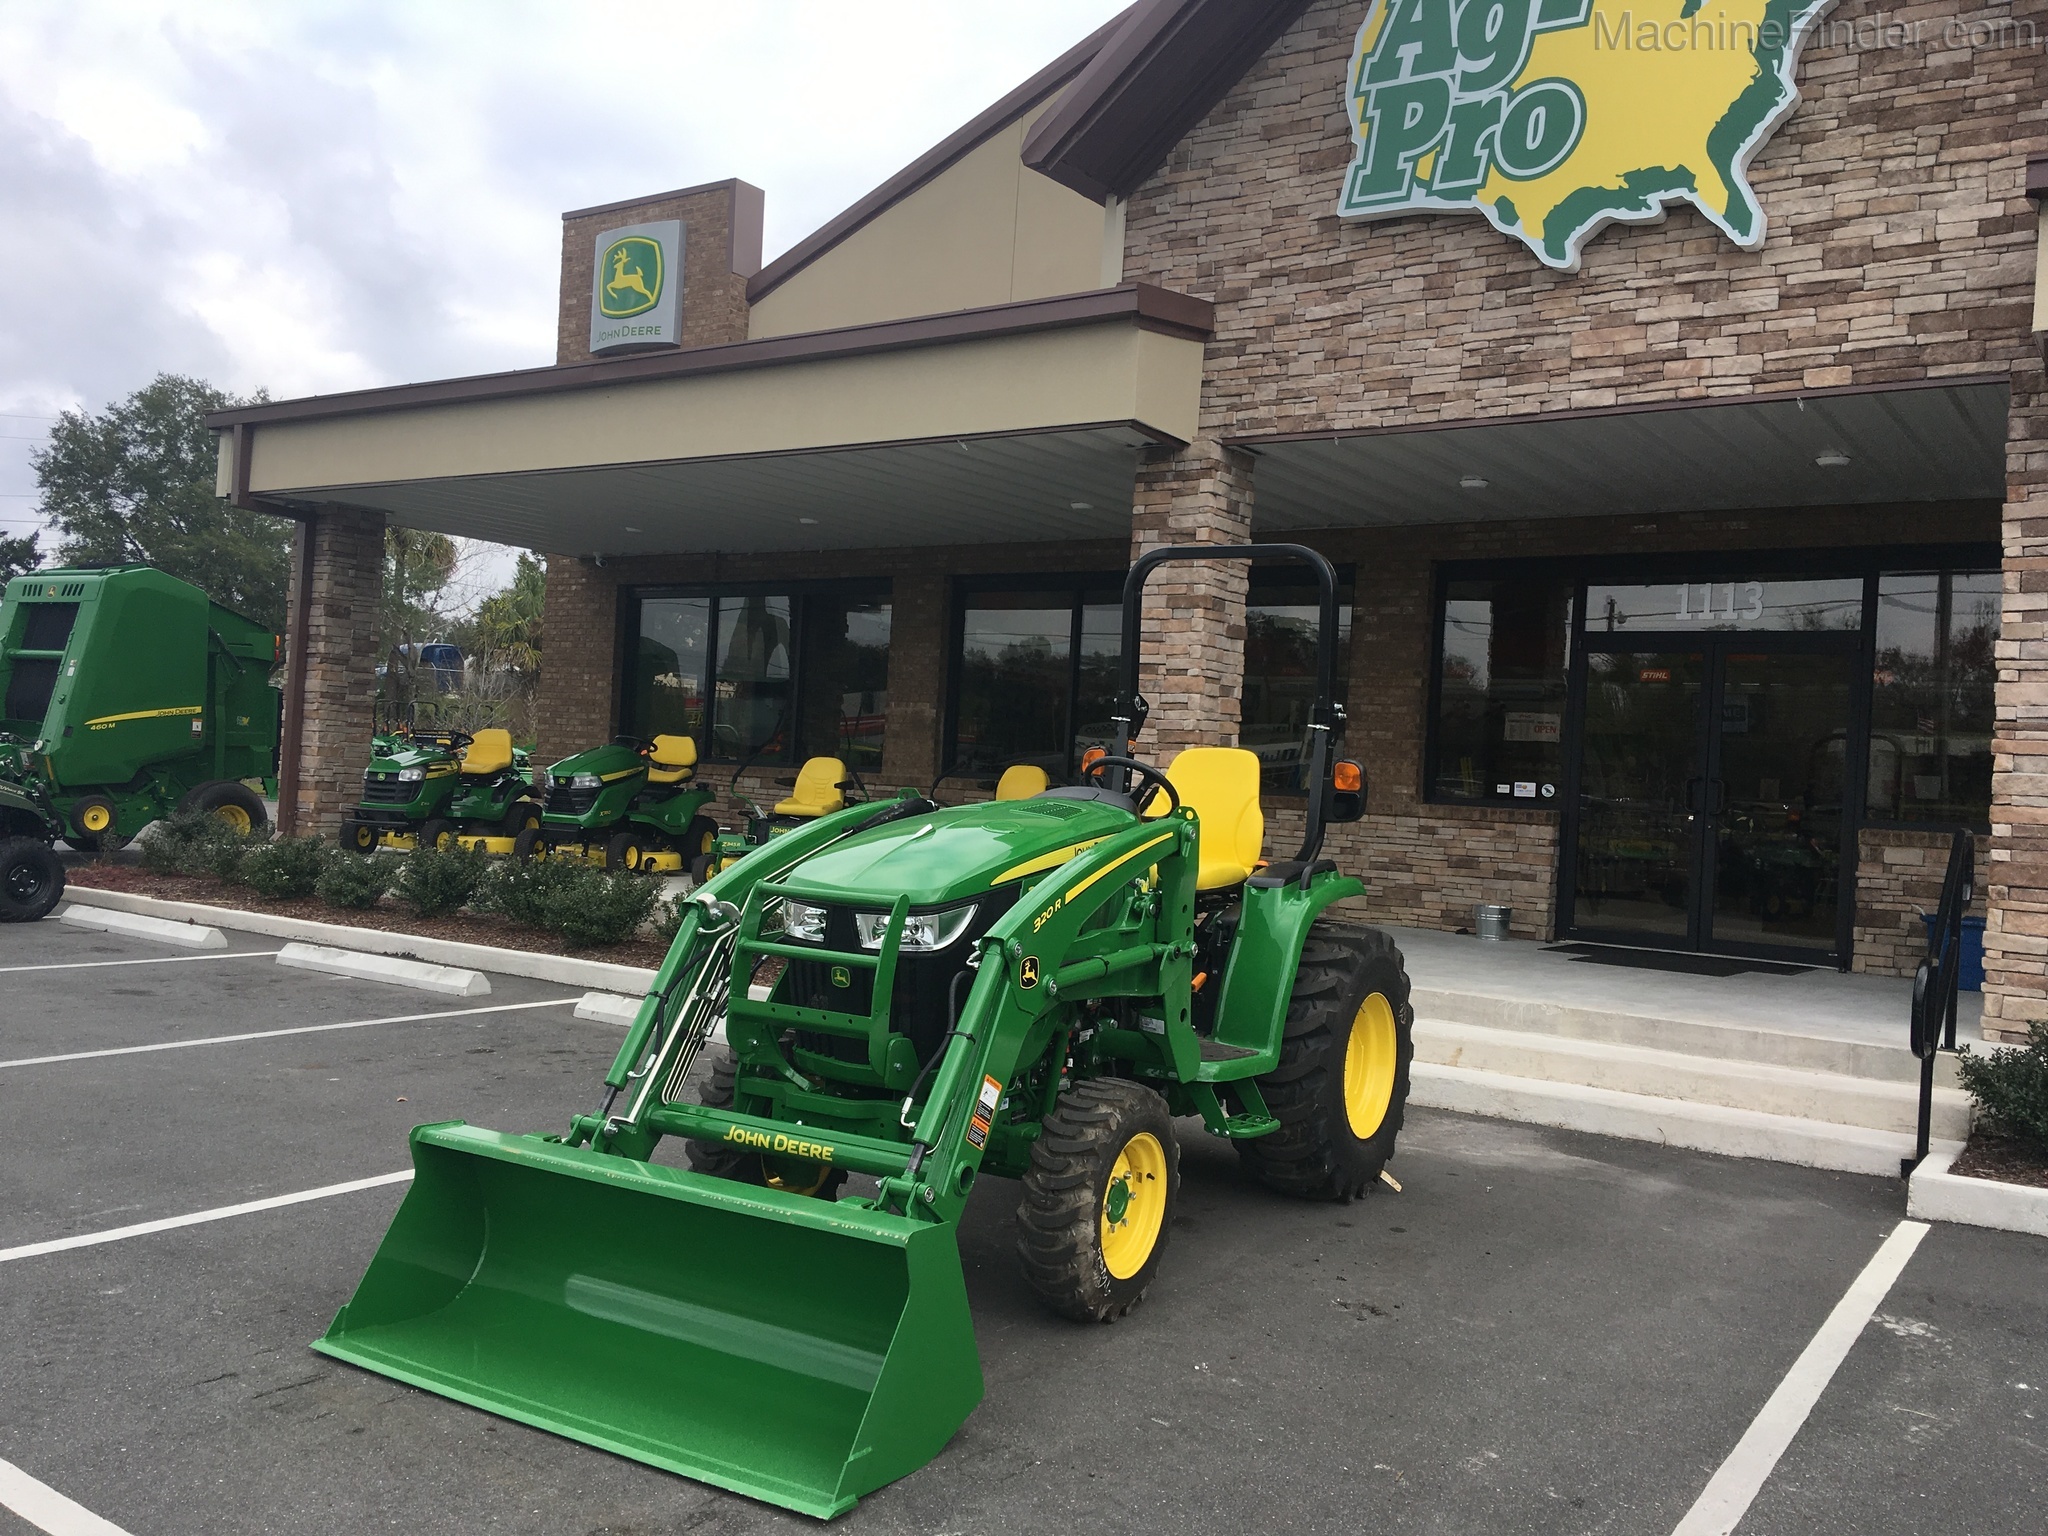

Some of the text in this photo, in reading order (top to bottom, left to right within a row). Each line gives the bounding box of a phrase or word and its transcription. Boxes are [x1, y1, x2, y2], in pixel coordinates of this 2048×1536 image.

[1352, 78, 1582, 203] Pro
[596, 325, 662, 342] JOHN DEERE
[1675, 581, 1764, 620] 1113
[1641, 671, 1668, 679] STIHL
[155, 707, 197, 717] JOHN DEERE
[1534, 725, 1557, 734] OPEN
[723, 1125, 835, 1162] JOHN DEERE
